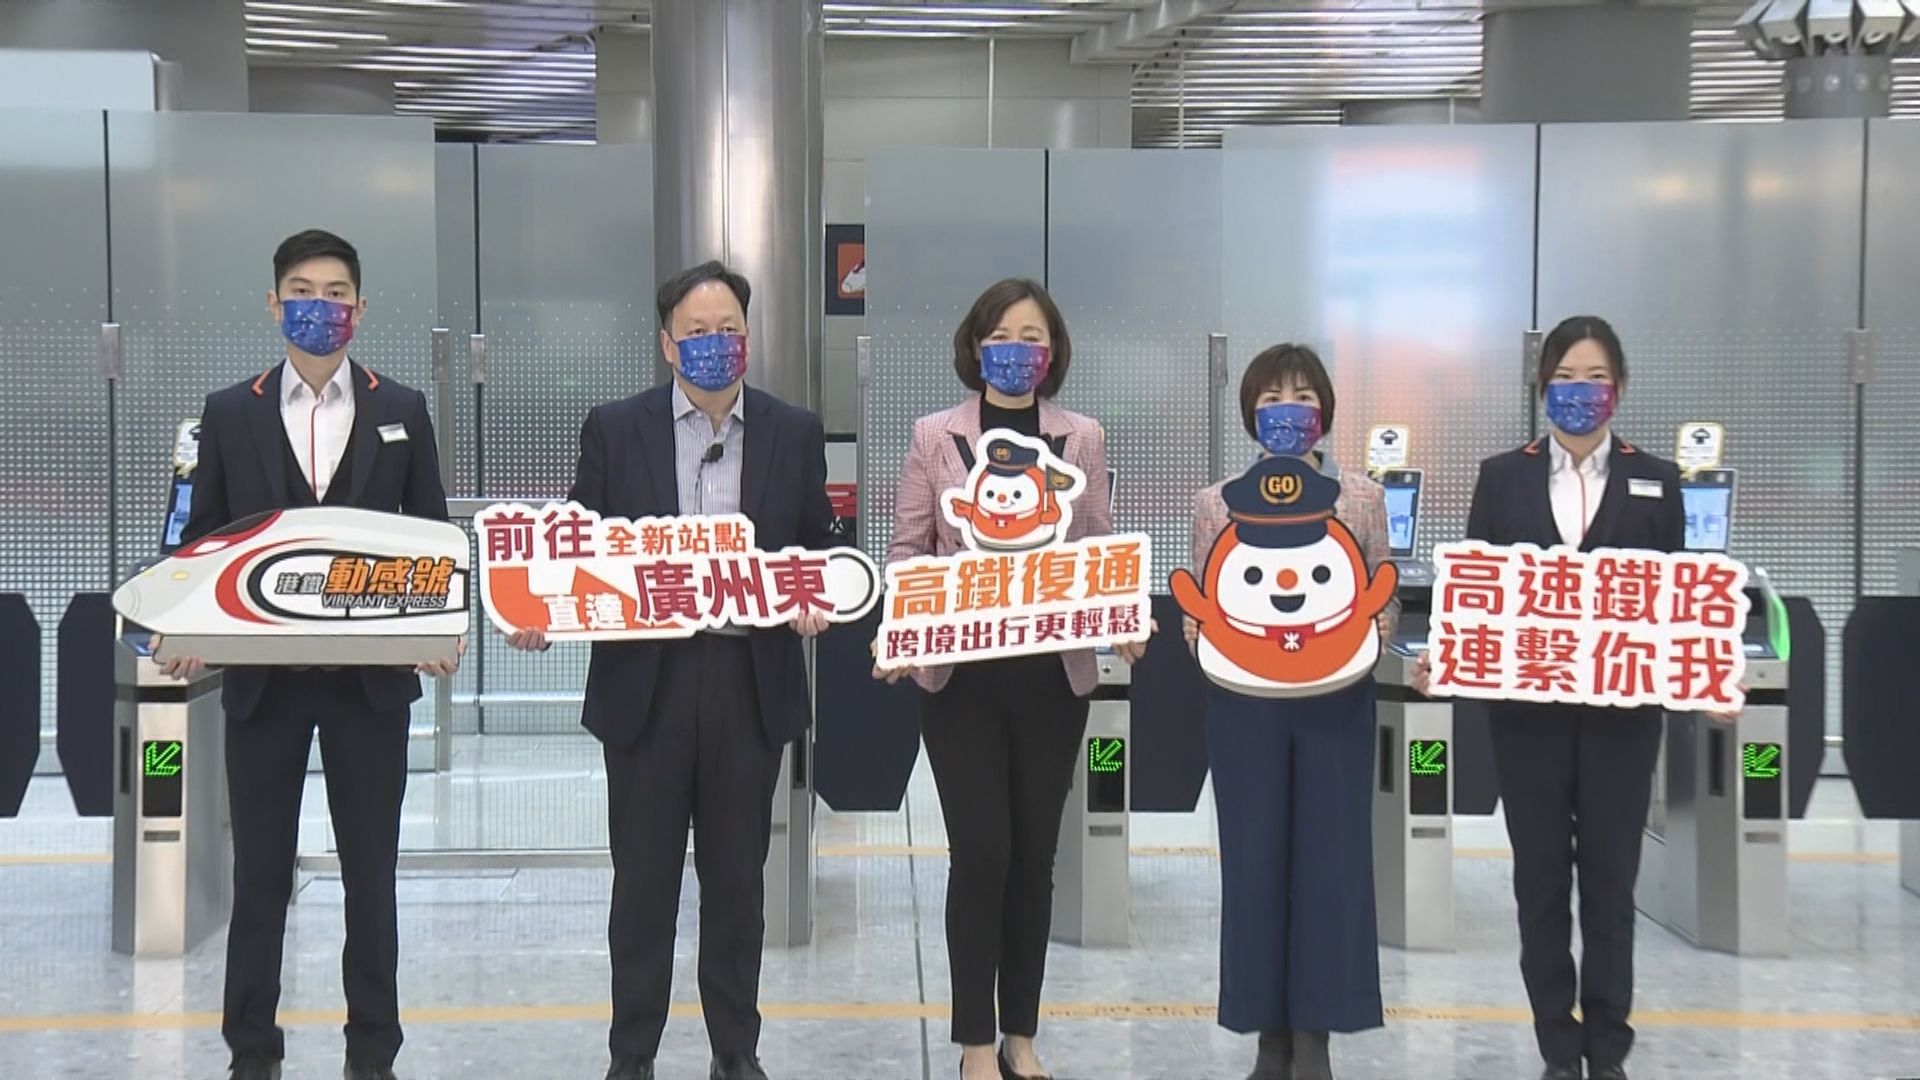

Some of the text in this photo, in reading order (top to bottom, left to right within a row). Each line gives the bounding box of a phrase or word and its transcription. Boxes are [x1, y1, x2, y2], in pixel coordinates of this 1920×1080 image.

[1268, 475, 1295, 494] GO
[483, 510, 747, 561] 前往 全新站點
[275, 556, 456, 595] 港鐵 動感號
[322, 594, 448, 608] VIBRANT EXPRESS
[543, 555, 836, 632] 直達 廣州東
[892, 541, 1141, 619] 高鐵復通
[1442, 550, 1738, 629] 高速鐵路
[886, 603, 1141, 660] 跨境出行更輕鬆
[1438, 621, 1736, 703] 連繫你我
